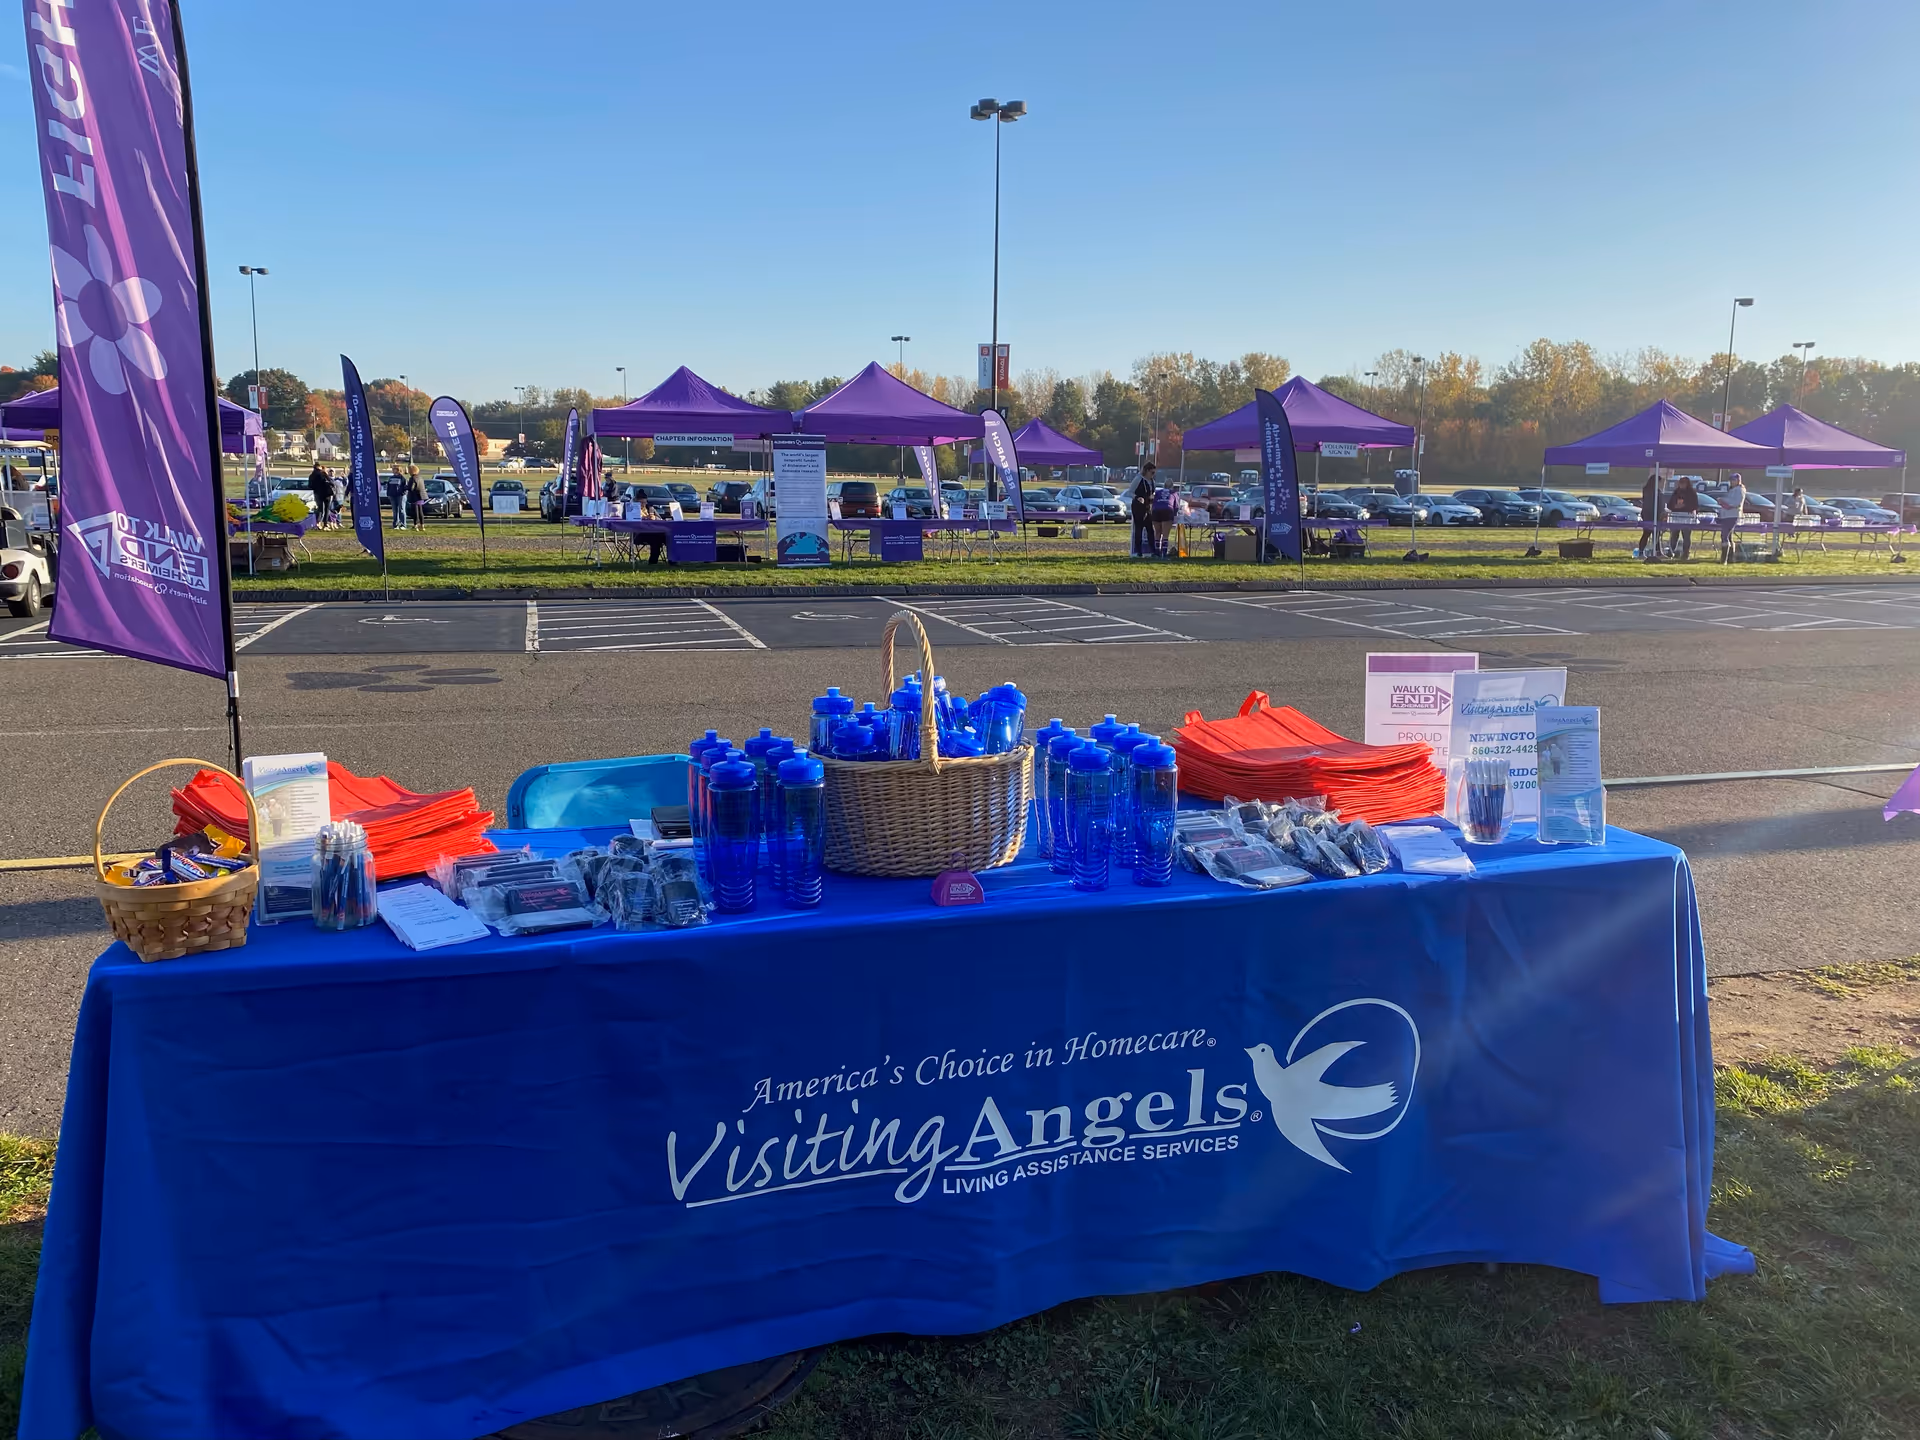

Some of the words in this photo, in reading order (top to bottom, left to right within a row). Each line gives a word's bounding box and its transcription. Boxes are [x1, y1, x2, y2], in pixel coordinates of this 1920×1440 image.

[1392, 685, 1420, 693] WALK
[1422, 685, 1434, 693] TO
[1392, 694, 1435, 704] END
[1461, 703, 1496, 719] Visiting
[1495, 703, 1535, 714] Angels
[1398, 732, 1442, 741] PROUD
[1469, 731, 1537, 742] NEWINGTO
[742, 1055, 905, 1113] America's
[915, 1049, 1014, 1086] Choice
[1024, 1041, 1054, 1069] in
[667, 1098, 959, 1204] Visiting
[954, 1067, 1249, 1163] Angels
[942, 1169, 1009, 1195] LIVING
[1012, 1145, 1136, 1181] ASSISTANCE
[1142, 1134, 1239, 1161] SERVICES
